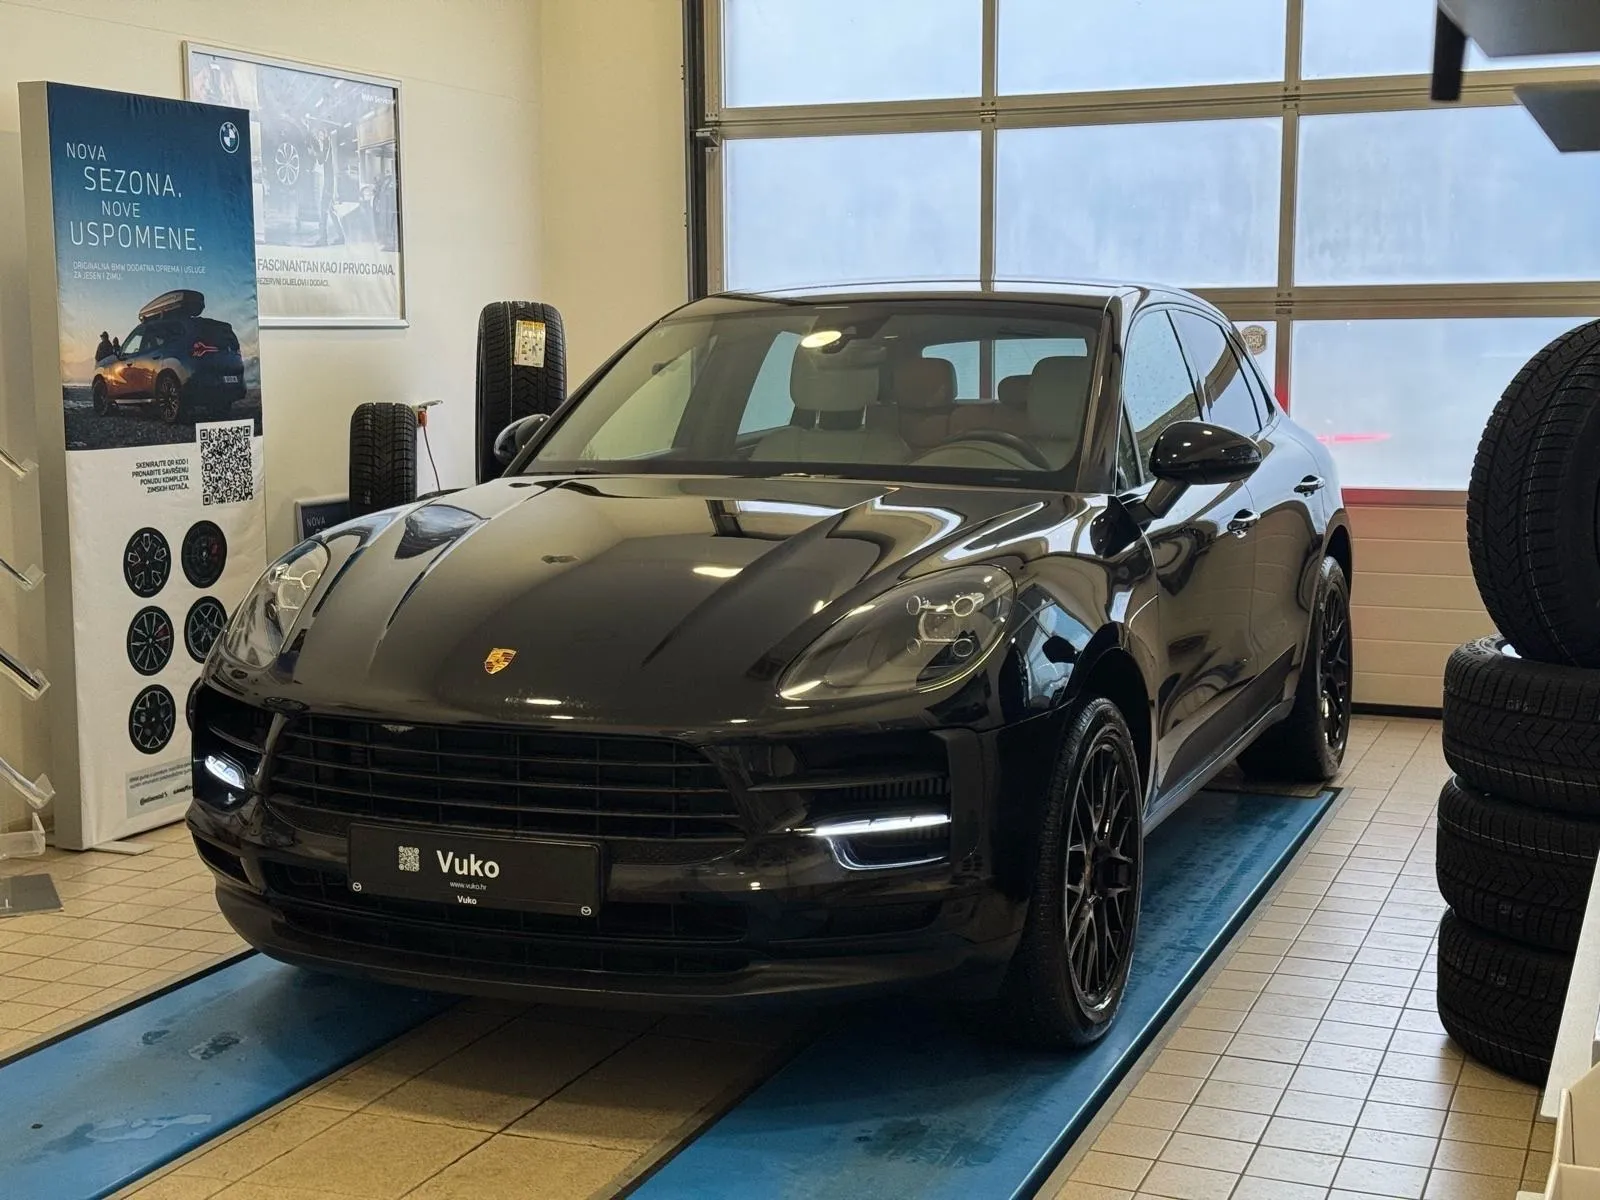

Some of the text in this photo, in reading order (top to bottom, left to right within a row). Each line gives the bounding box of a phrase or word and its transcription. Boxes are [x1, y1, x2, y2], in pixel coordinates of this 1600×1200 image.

[66, 142, 107, 161] NOVA
[84, 166, 182, 198] SEZONA.
[101, 200, 141, 218] NOVE
[70, 221, 203, 251] USPOMENE.
[73, 261, 110, 271] ORIGINALNA
[126, 263, 155, 272] DODATNA
[155, 265, 180, 273] OPREMA
[257, 258, 319, 273] FASCINANTAN
[319, 261, 338, 274] KAO
[342, 262, 371, 275] PRVOG
[371, 264, 396, 276] DANA.
[73, 270, 82, 279] ZA
[135, 460, 166, 469] SKENIRAJTE
[140, 474, 189, 486] PONUDU KOMPLETA
[306, 516, 326, 527] NOVA
[436, 850, 500, 878] Vuko
[449, 881, 487, 891] www.vuko.hr
[457, 895, 477, 905] Vuko
